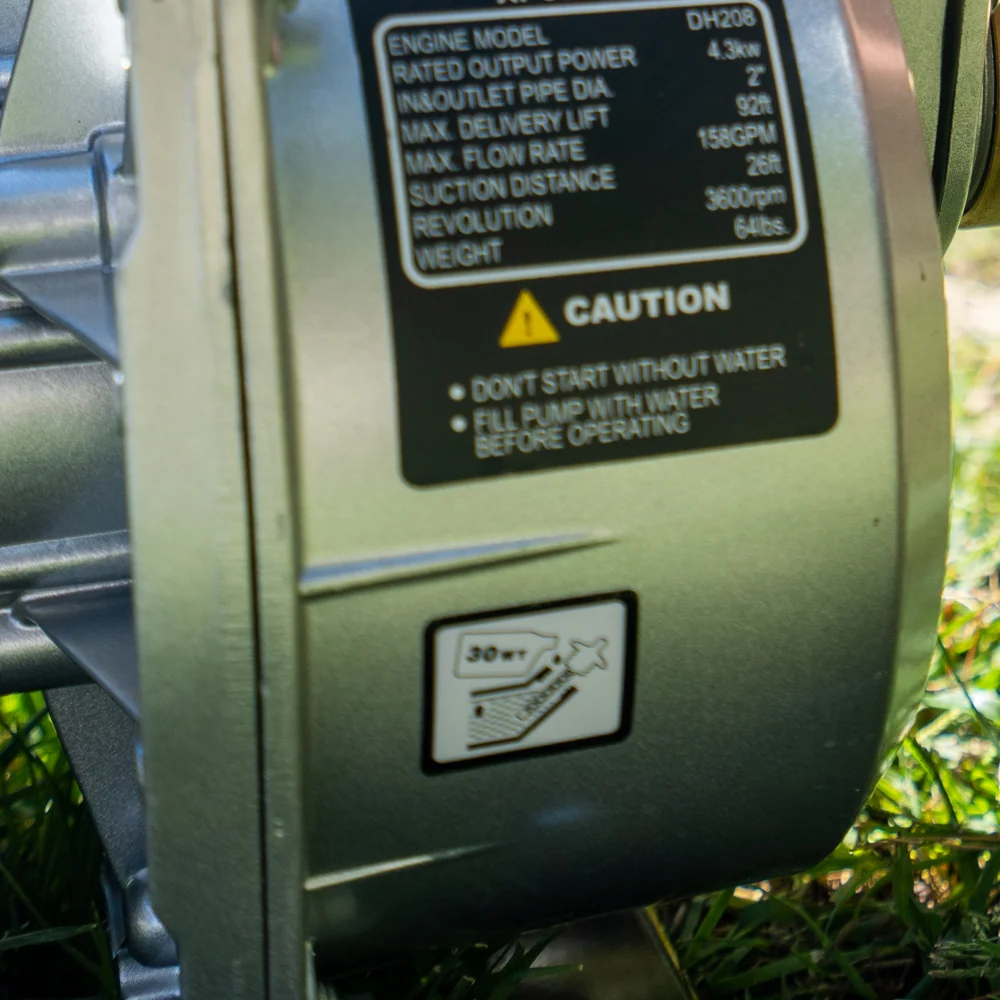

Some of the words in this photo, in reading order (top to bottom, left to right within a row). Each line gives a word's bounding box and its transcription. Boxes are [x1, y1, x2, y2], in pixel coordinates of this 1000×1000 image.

[686, 7, 757, 31] DH208
[387, 30, 470, 56] ENGINE
[473, 24, 551, 50] MODEL
[392, 56, 466, 84] RATED
[468, 50, 553, 80] OUTPUT
[557, 44, 639, 72] POWER
[397, 82, 516, 114] IN&OUTLET
[520, 78, 570, 104] PIPE
[572, 75, 615, 101] DIA.
[735, 93, 774, 117] 92ft
[402, 118, 455, 144] MAX.
[458, 108, 567, 140] DELIVERY
[566, 105, 611, 132] LIFT
[697, 121, 778, 150] 158GPM
[462, 139, 526, 171] FLOW
[529, 136, 587, 163] RATE
[746, 152, 783, 176] 26ft
[408, 175, 508, 208] SUCTION
[510, 164, 618, 198] DISTANCE
[704, 184, 788, 211] 3600rpm
[412, 203, 554, 239] REVOLUTION
[415, 238, 503, 270] WEIGHT
[564, 282, 732, 327] CAUTION
[471, 370, 538, 402] DON'T
[541, 362, 609, 394] START
[611, 352, 711, 386] WITHOUT
[713, 343, 787, 374] WATER
[473, 406, 518, 434] FILL
[521, 397, 585, 427] PUMP
[586, 391, 643, 421] WITH
[645, 381, 721, 412] WATER
[474, 427, 565, 459] BEFORE
[567, 411, 691, 447] OPERATING
